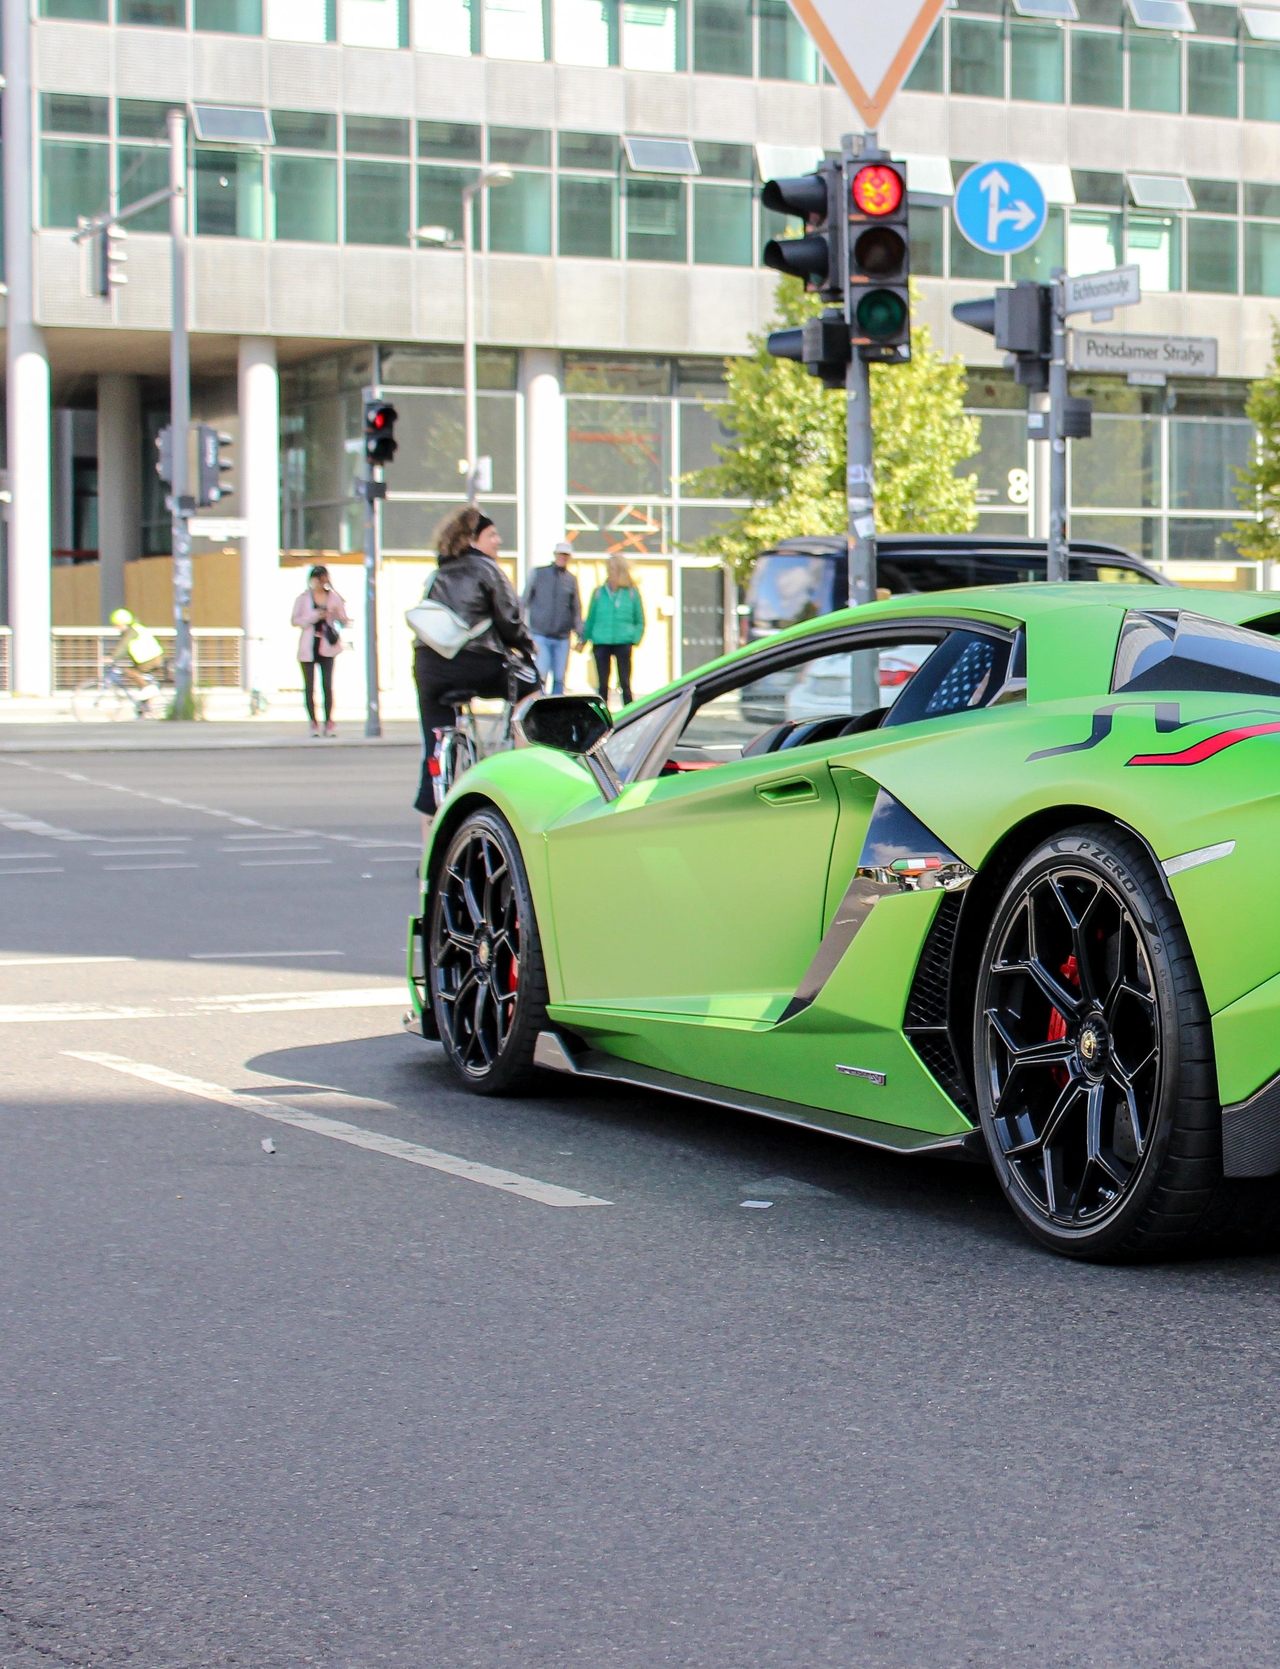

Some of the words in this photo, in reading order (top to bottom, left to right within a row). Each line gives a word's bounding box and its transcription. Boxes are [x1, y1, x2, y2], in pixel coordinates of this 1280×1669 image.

[1087, 339, 1159, 360] Potsdamer
[1163, 342, 1205, 366] Straße
[1007, 468, 1029, 504] 8
[1077, 842, 1091, 852] P
[1091, 847, 1138, 894] ZERO
